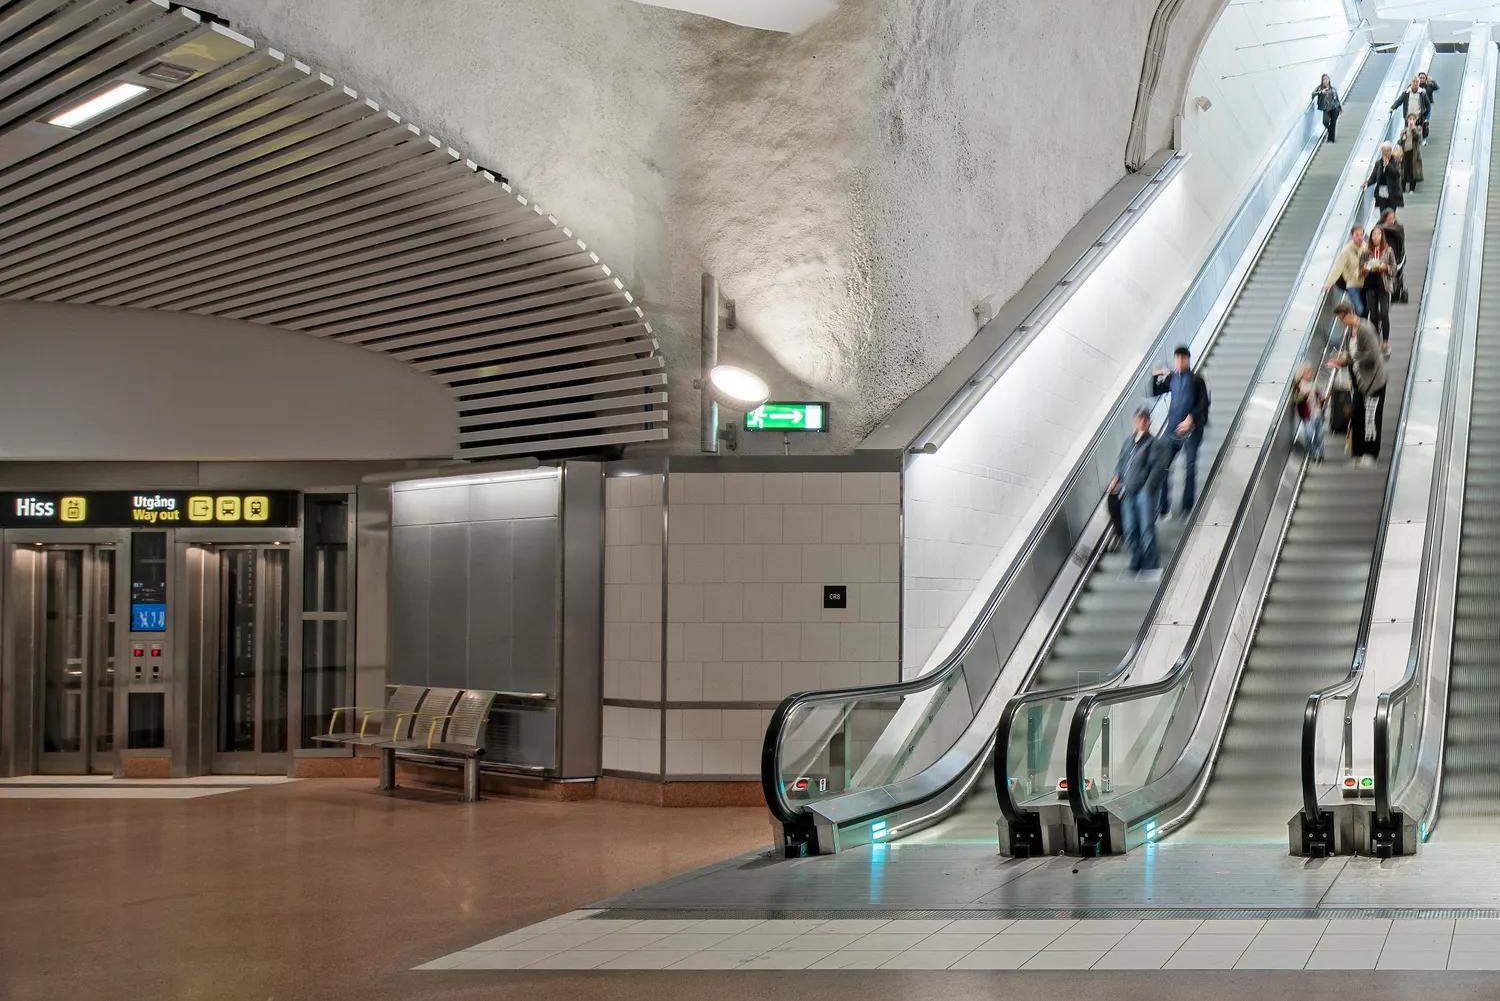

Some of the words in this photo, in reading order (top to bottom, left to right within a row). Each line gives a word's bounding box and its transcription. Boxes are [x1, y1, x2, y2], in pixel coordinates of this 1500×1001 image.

[16, 497, 54, 516] Hiss
[133, 495, 175, 510] Utgång
[133, 509, 158, 523] Way
[159, 510, 180, 520] out
